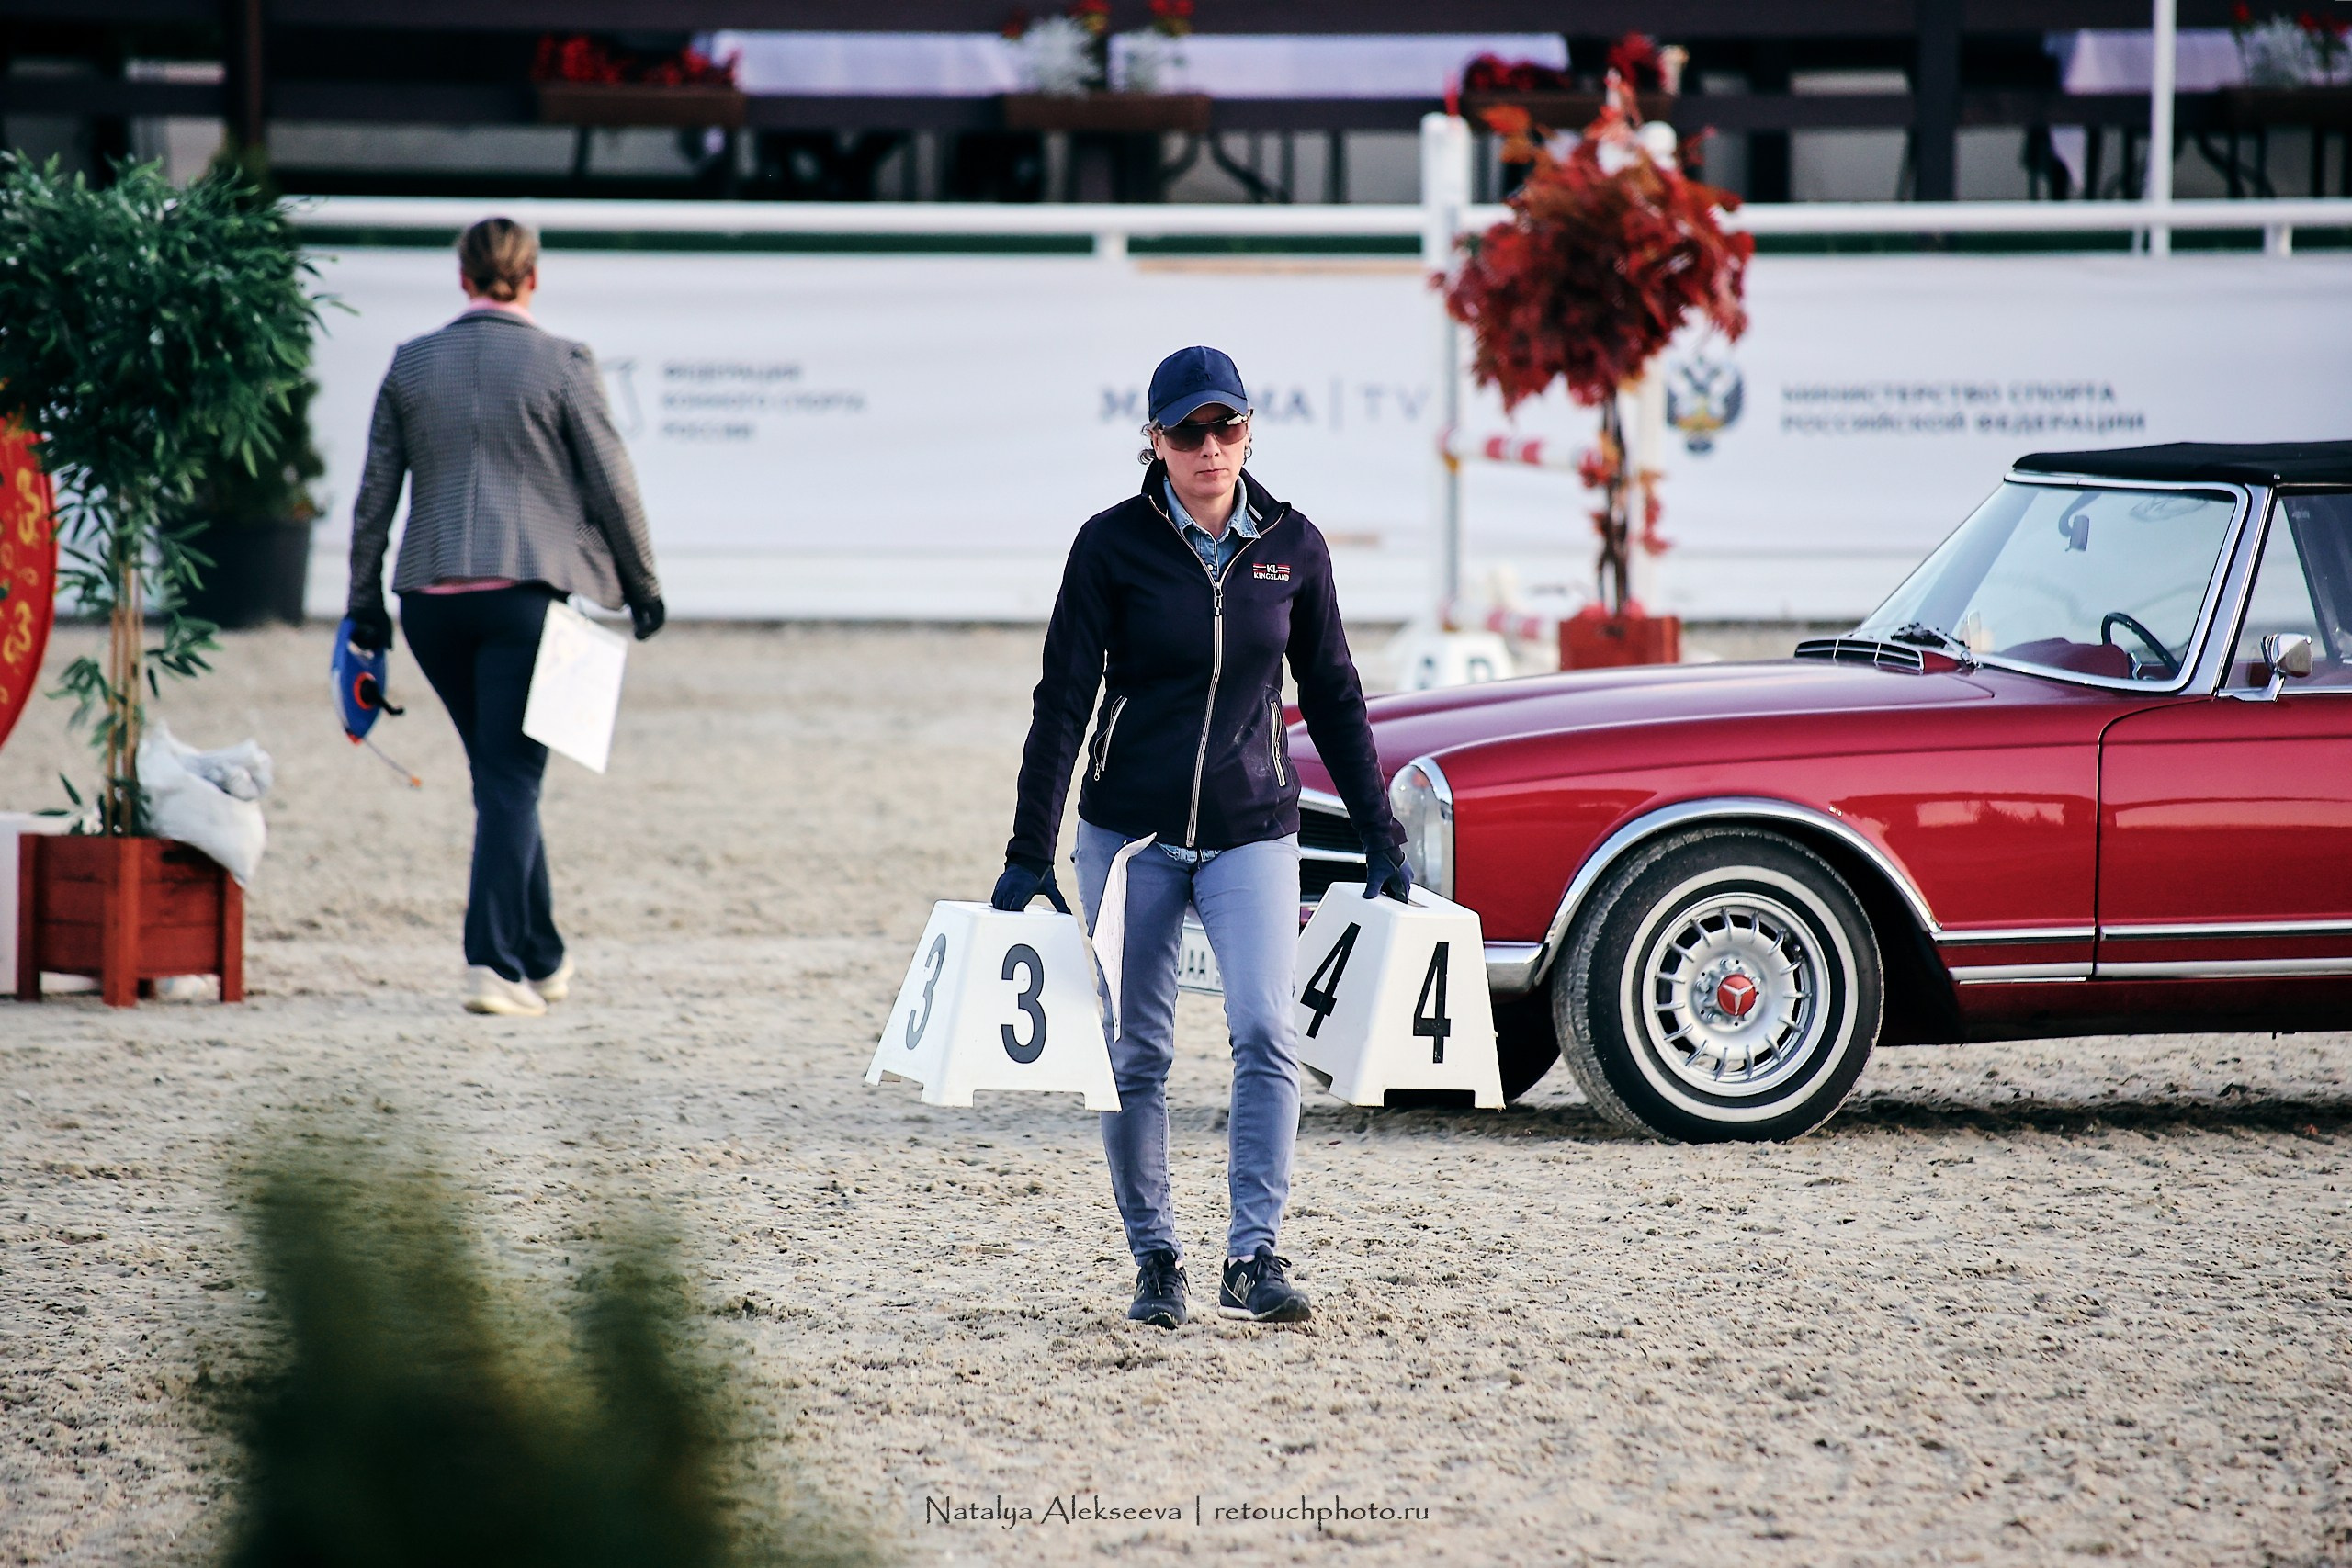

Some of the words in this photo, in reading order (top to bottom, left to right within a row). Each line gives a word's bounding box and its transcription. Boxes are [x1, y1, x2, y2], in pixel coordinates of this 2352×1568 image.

[1253, 572, 1290, 581] KINGSLAND
[1266, 564, 1278, 573] KL
[906, 932, 946, 1051] 3
[1001, 943, 1046, 1064] 3
[1300, 922, 1361, 1039] 4
[1413, 942, 1451, 1064] 4
